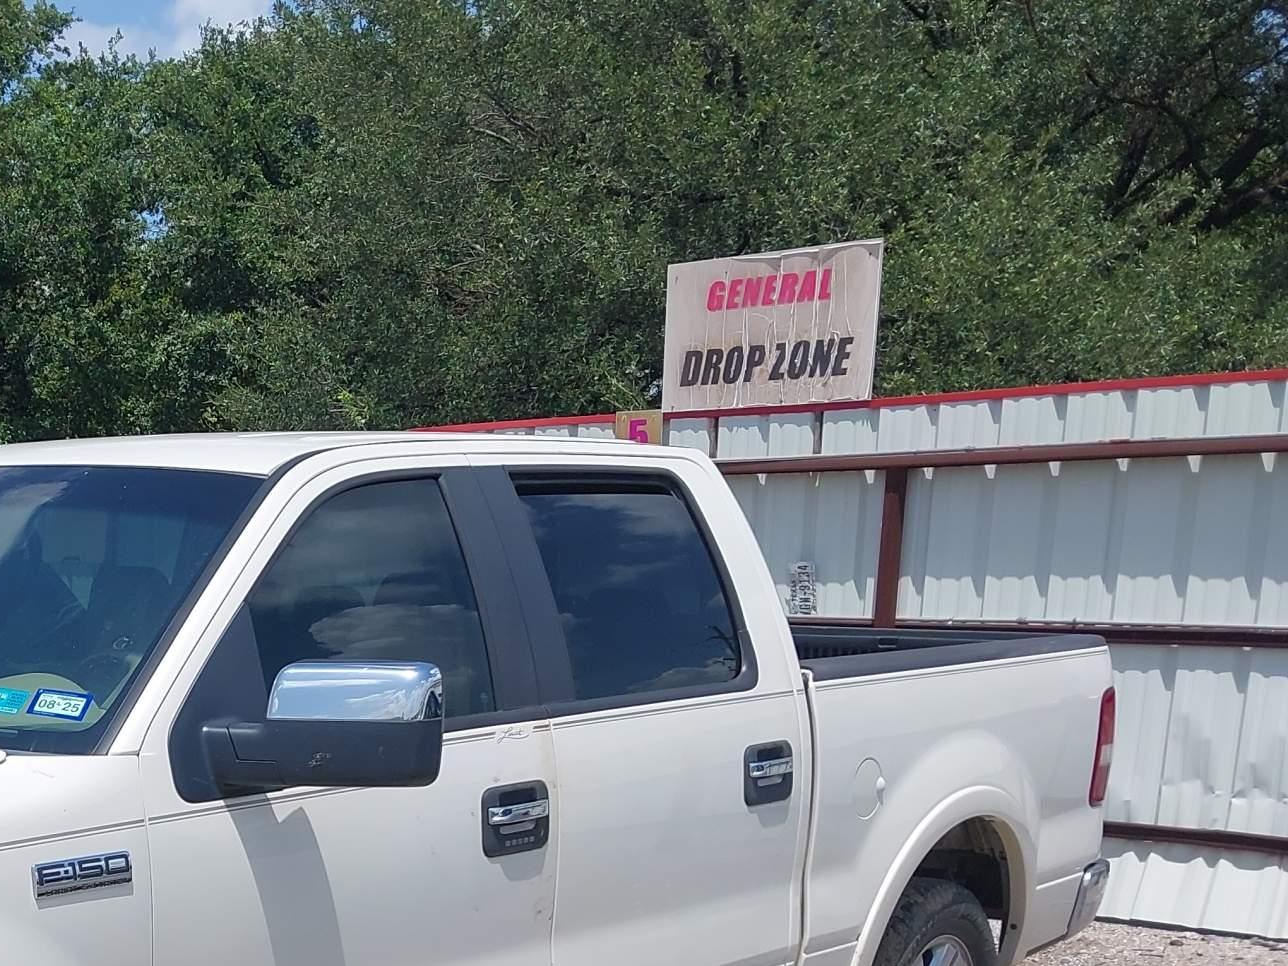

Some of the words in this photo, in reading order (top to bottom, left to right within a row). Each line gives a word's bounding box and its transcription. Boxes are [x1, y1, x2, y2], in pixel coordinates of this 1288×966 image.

[706, 268, 833, 312] GENERAL
[679, 344, 766, 388] DROP
[768, 336, 854, 381] ZONE
[628, 418, 650, 444] 5
[38, 698, 57, 710] 08
[62, 701, 81, 713] 25
